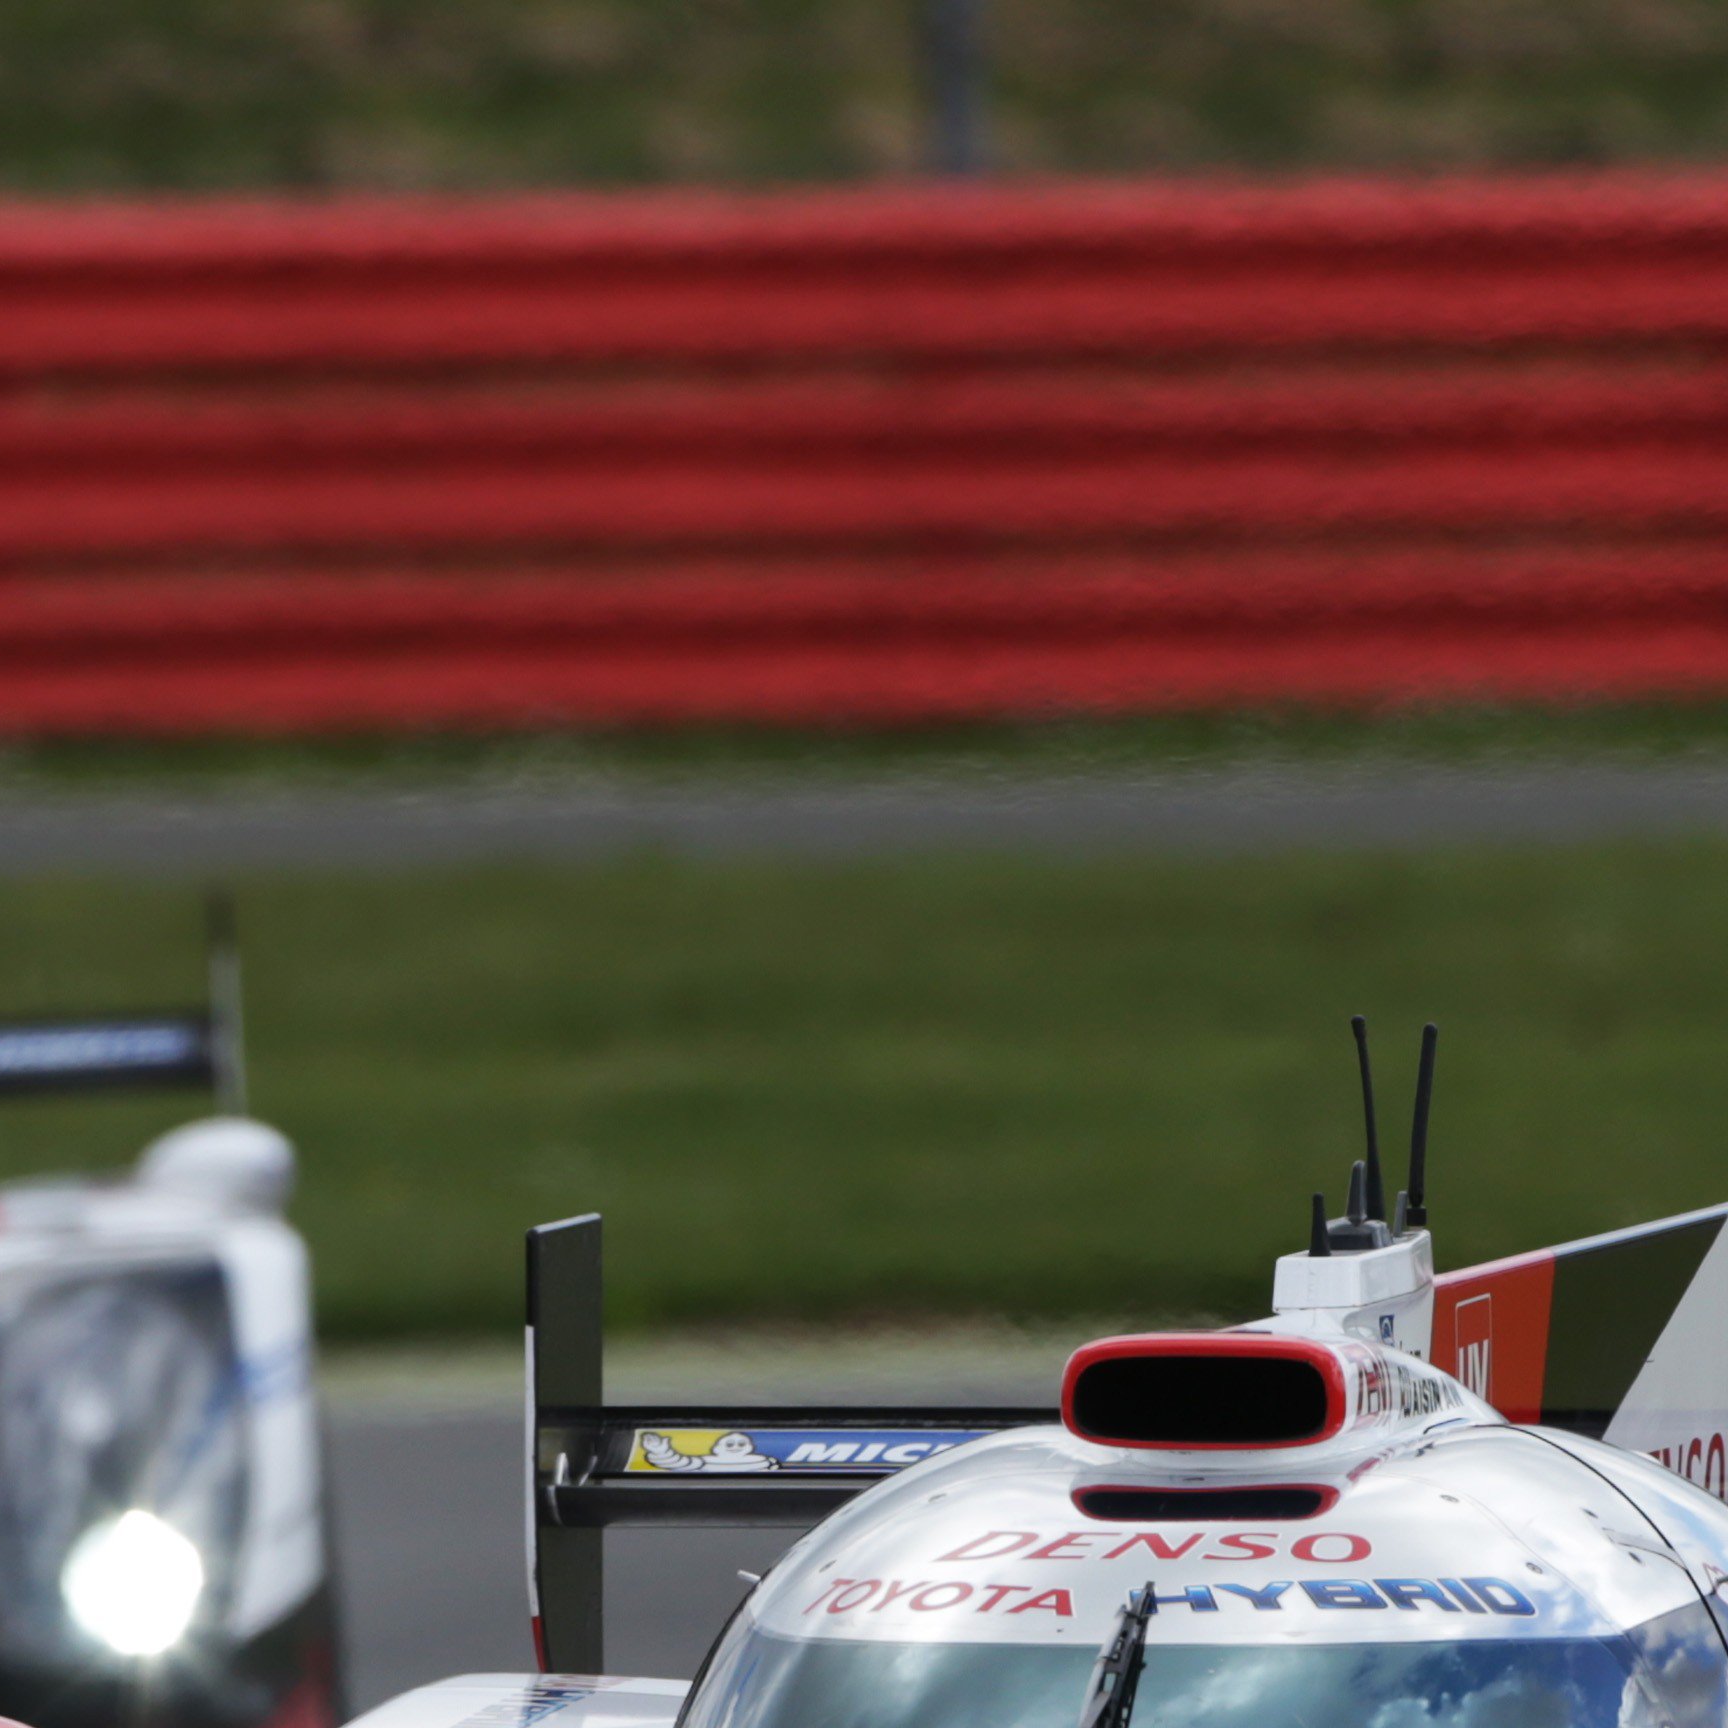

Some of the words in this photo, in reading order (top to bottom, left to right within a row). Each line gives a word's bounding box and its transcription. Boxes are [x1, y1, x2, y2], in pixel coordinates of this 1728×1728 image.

[932, 1530, 1373, 1564] DENSO
[802, 1578, 1075, 1617] TOYOTA
[1129, 1576, 1537, 1616] HYBRID
